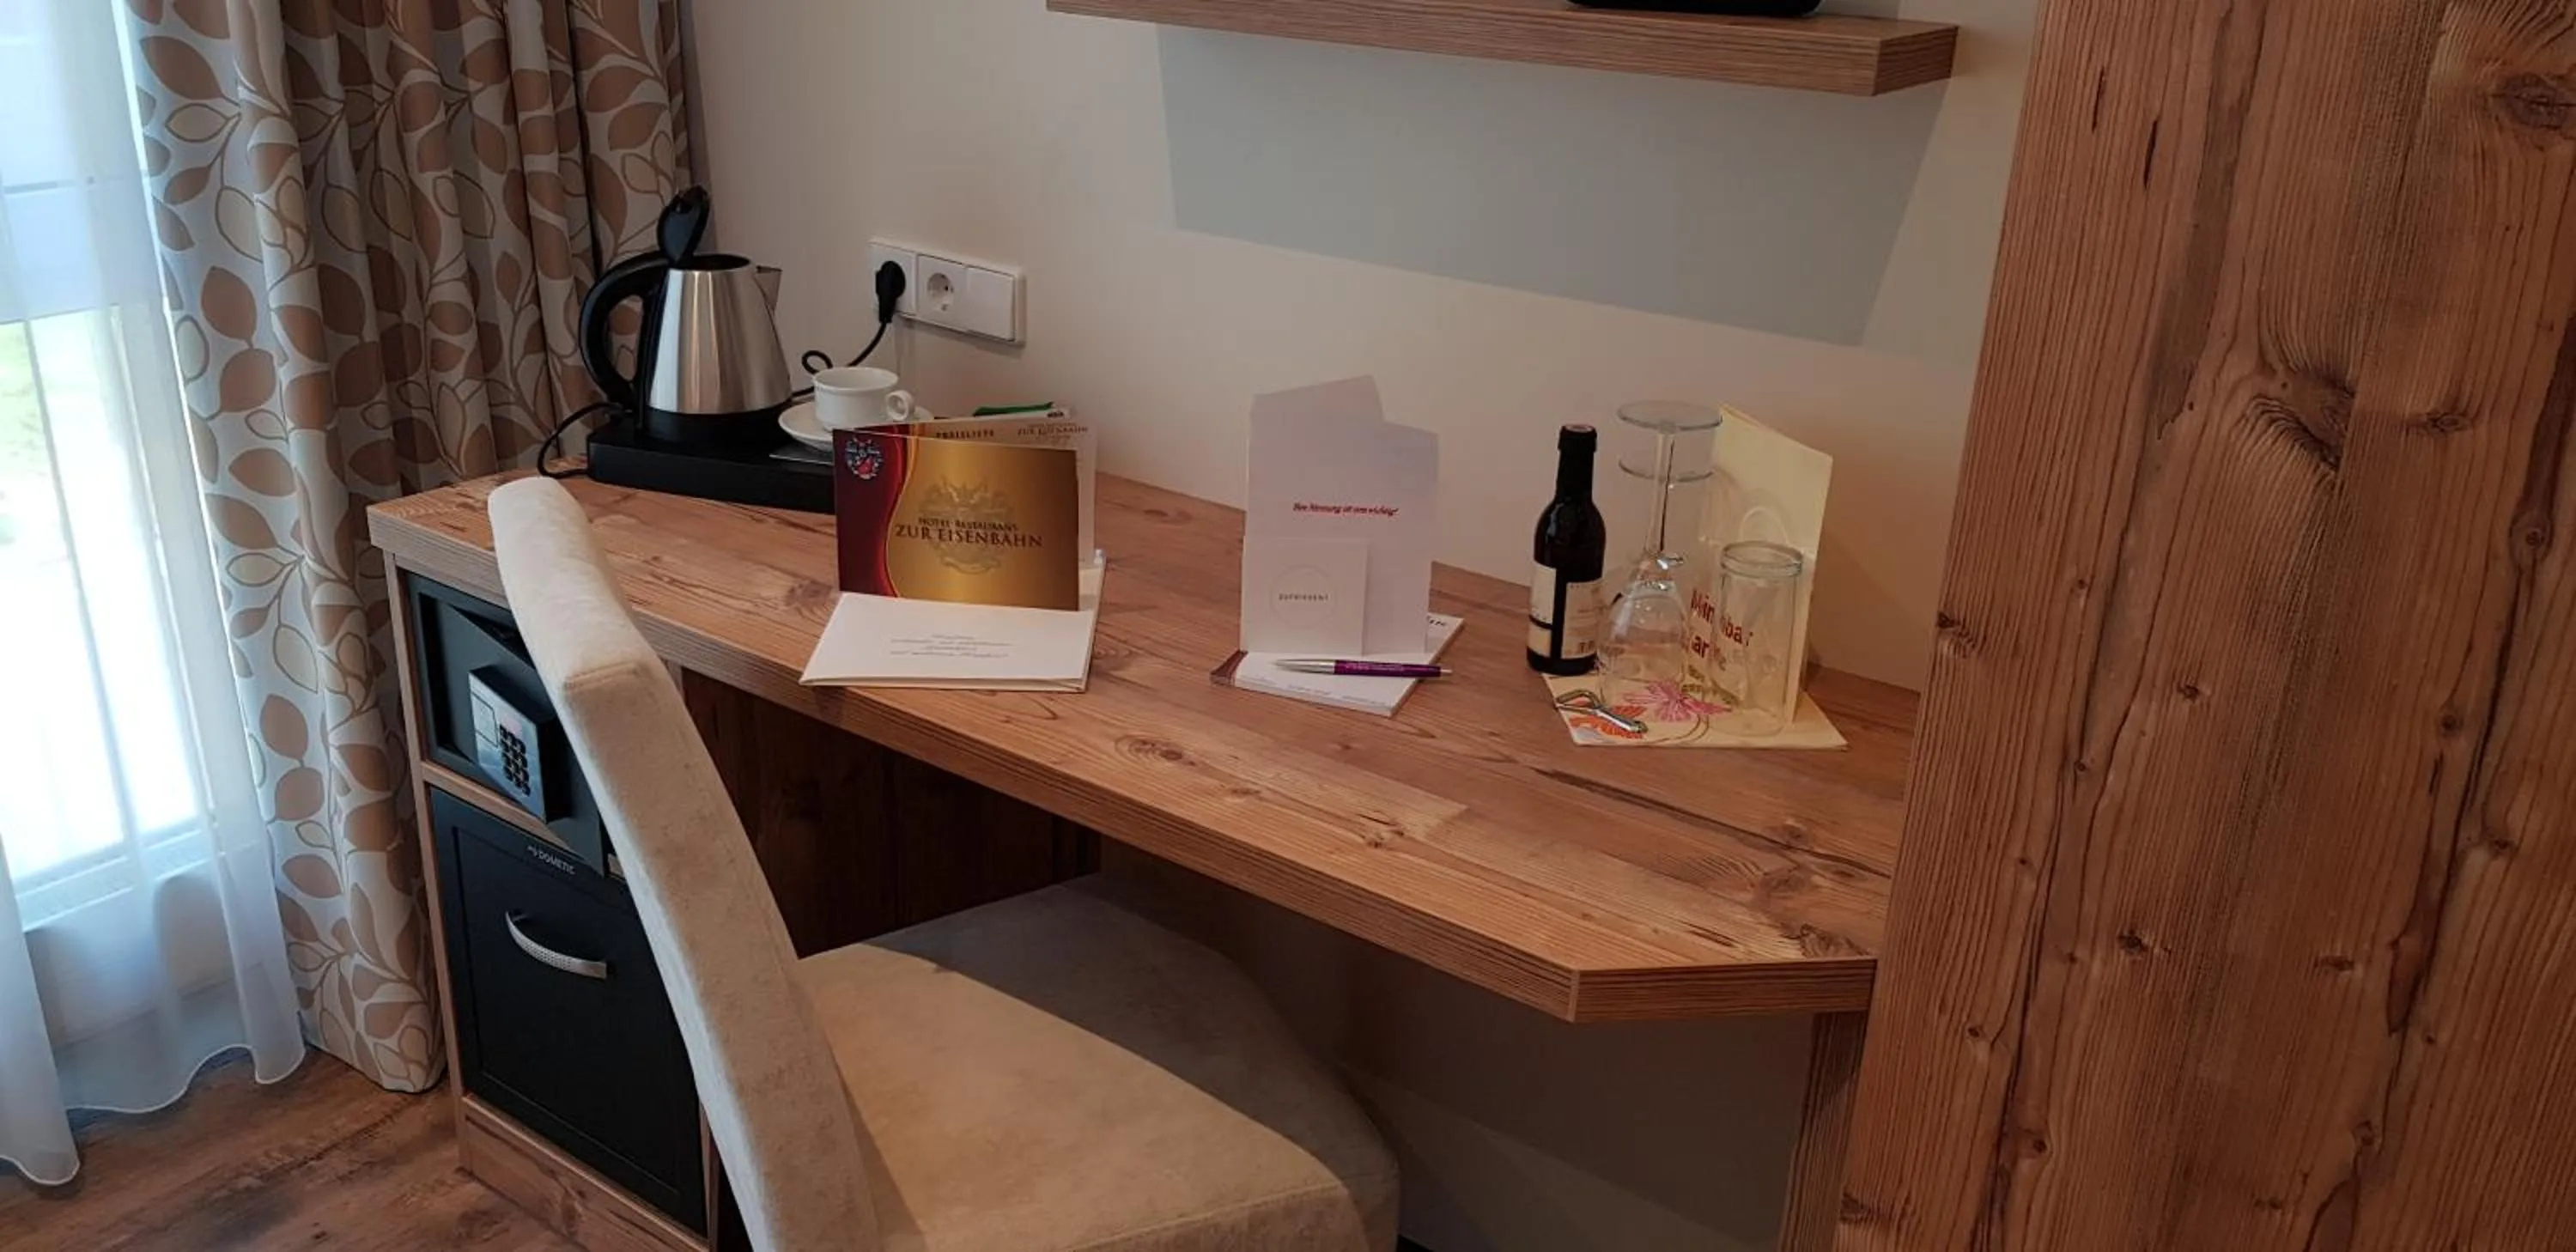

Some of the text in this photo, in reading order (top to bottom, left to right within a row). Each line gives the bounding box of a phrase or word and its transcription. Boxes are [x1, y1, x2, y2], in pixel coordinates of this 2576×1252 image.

[895, 524, 1044, 548] ZUR EISENBAHN
[538, 849, 576, 875] DOMETIC
